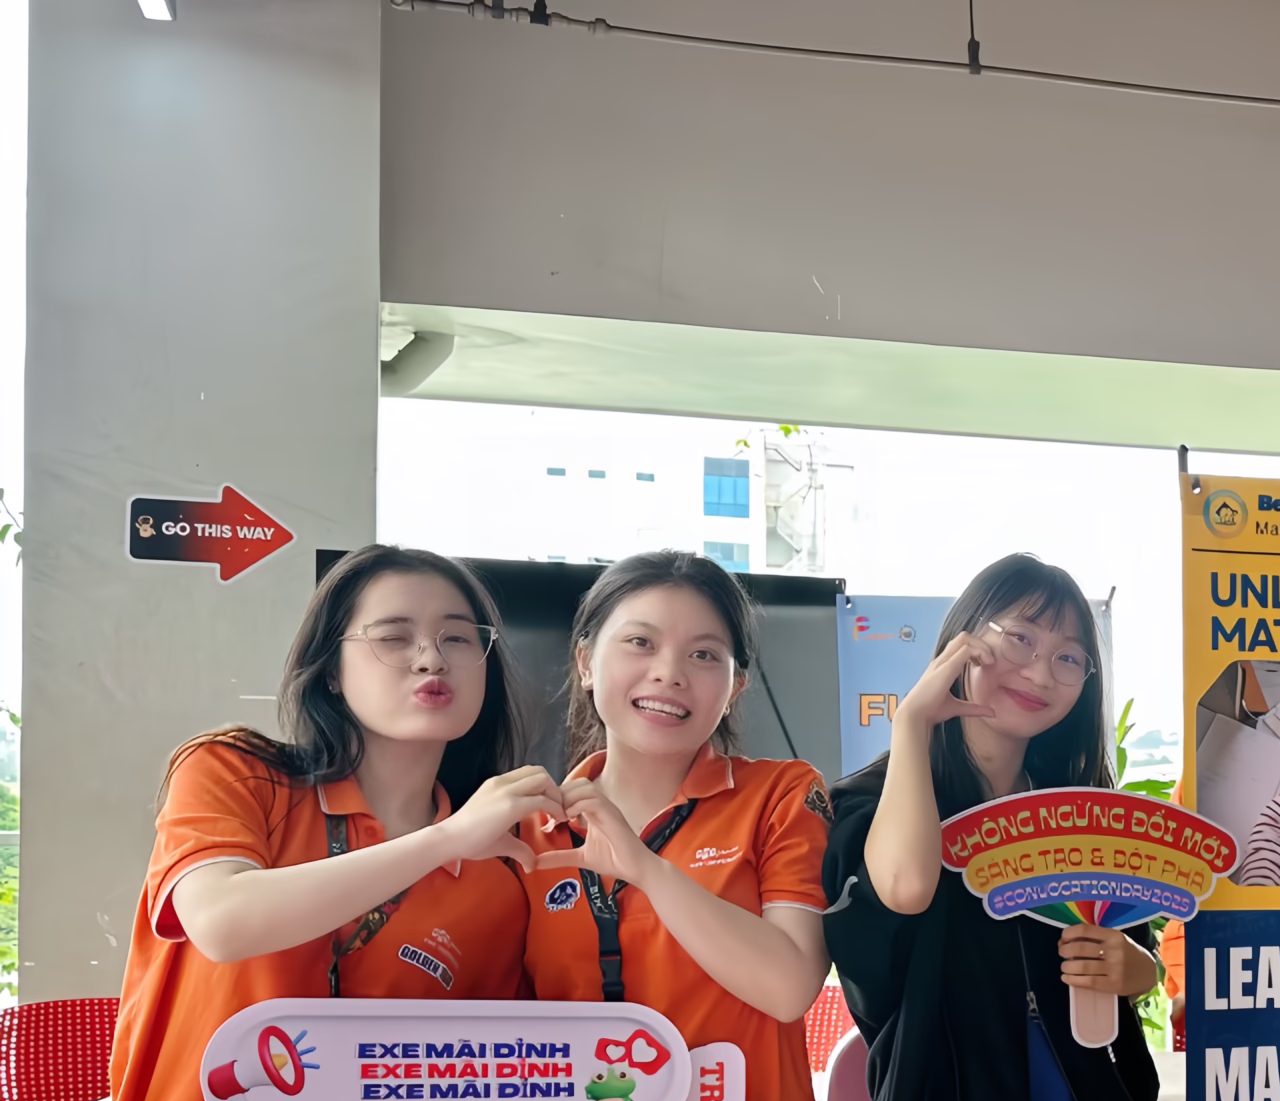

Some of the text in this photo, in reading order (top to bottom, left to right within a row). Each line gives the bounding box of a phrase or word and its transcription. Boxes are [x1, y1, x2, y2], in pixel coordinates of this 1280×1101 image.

[162, 522, 275, 540] GO THIS WAY
[946, 811, 1034, 861] KHÔNG
[1039, 801, 1125, 830] NGỪNG
[1038, 847, 1083, 872] TẠO
[1091, 848, 1105, 866] &
[994, 880, 1190, 912] #CONVOCATIONDAY2025
[357, 1043, 421, 1058] EXE
[425, 1039, 487, 1058] MÃI
[361, 1063, 422, 1079] EXE
[362, 1083, 424, 1100] EXE
[429, 1080, 491, 1099] MÃI
